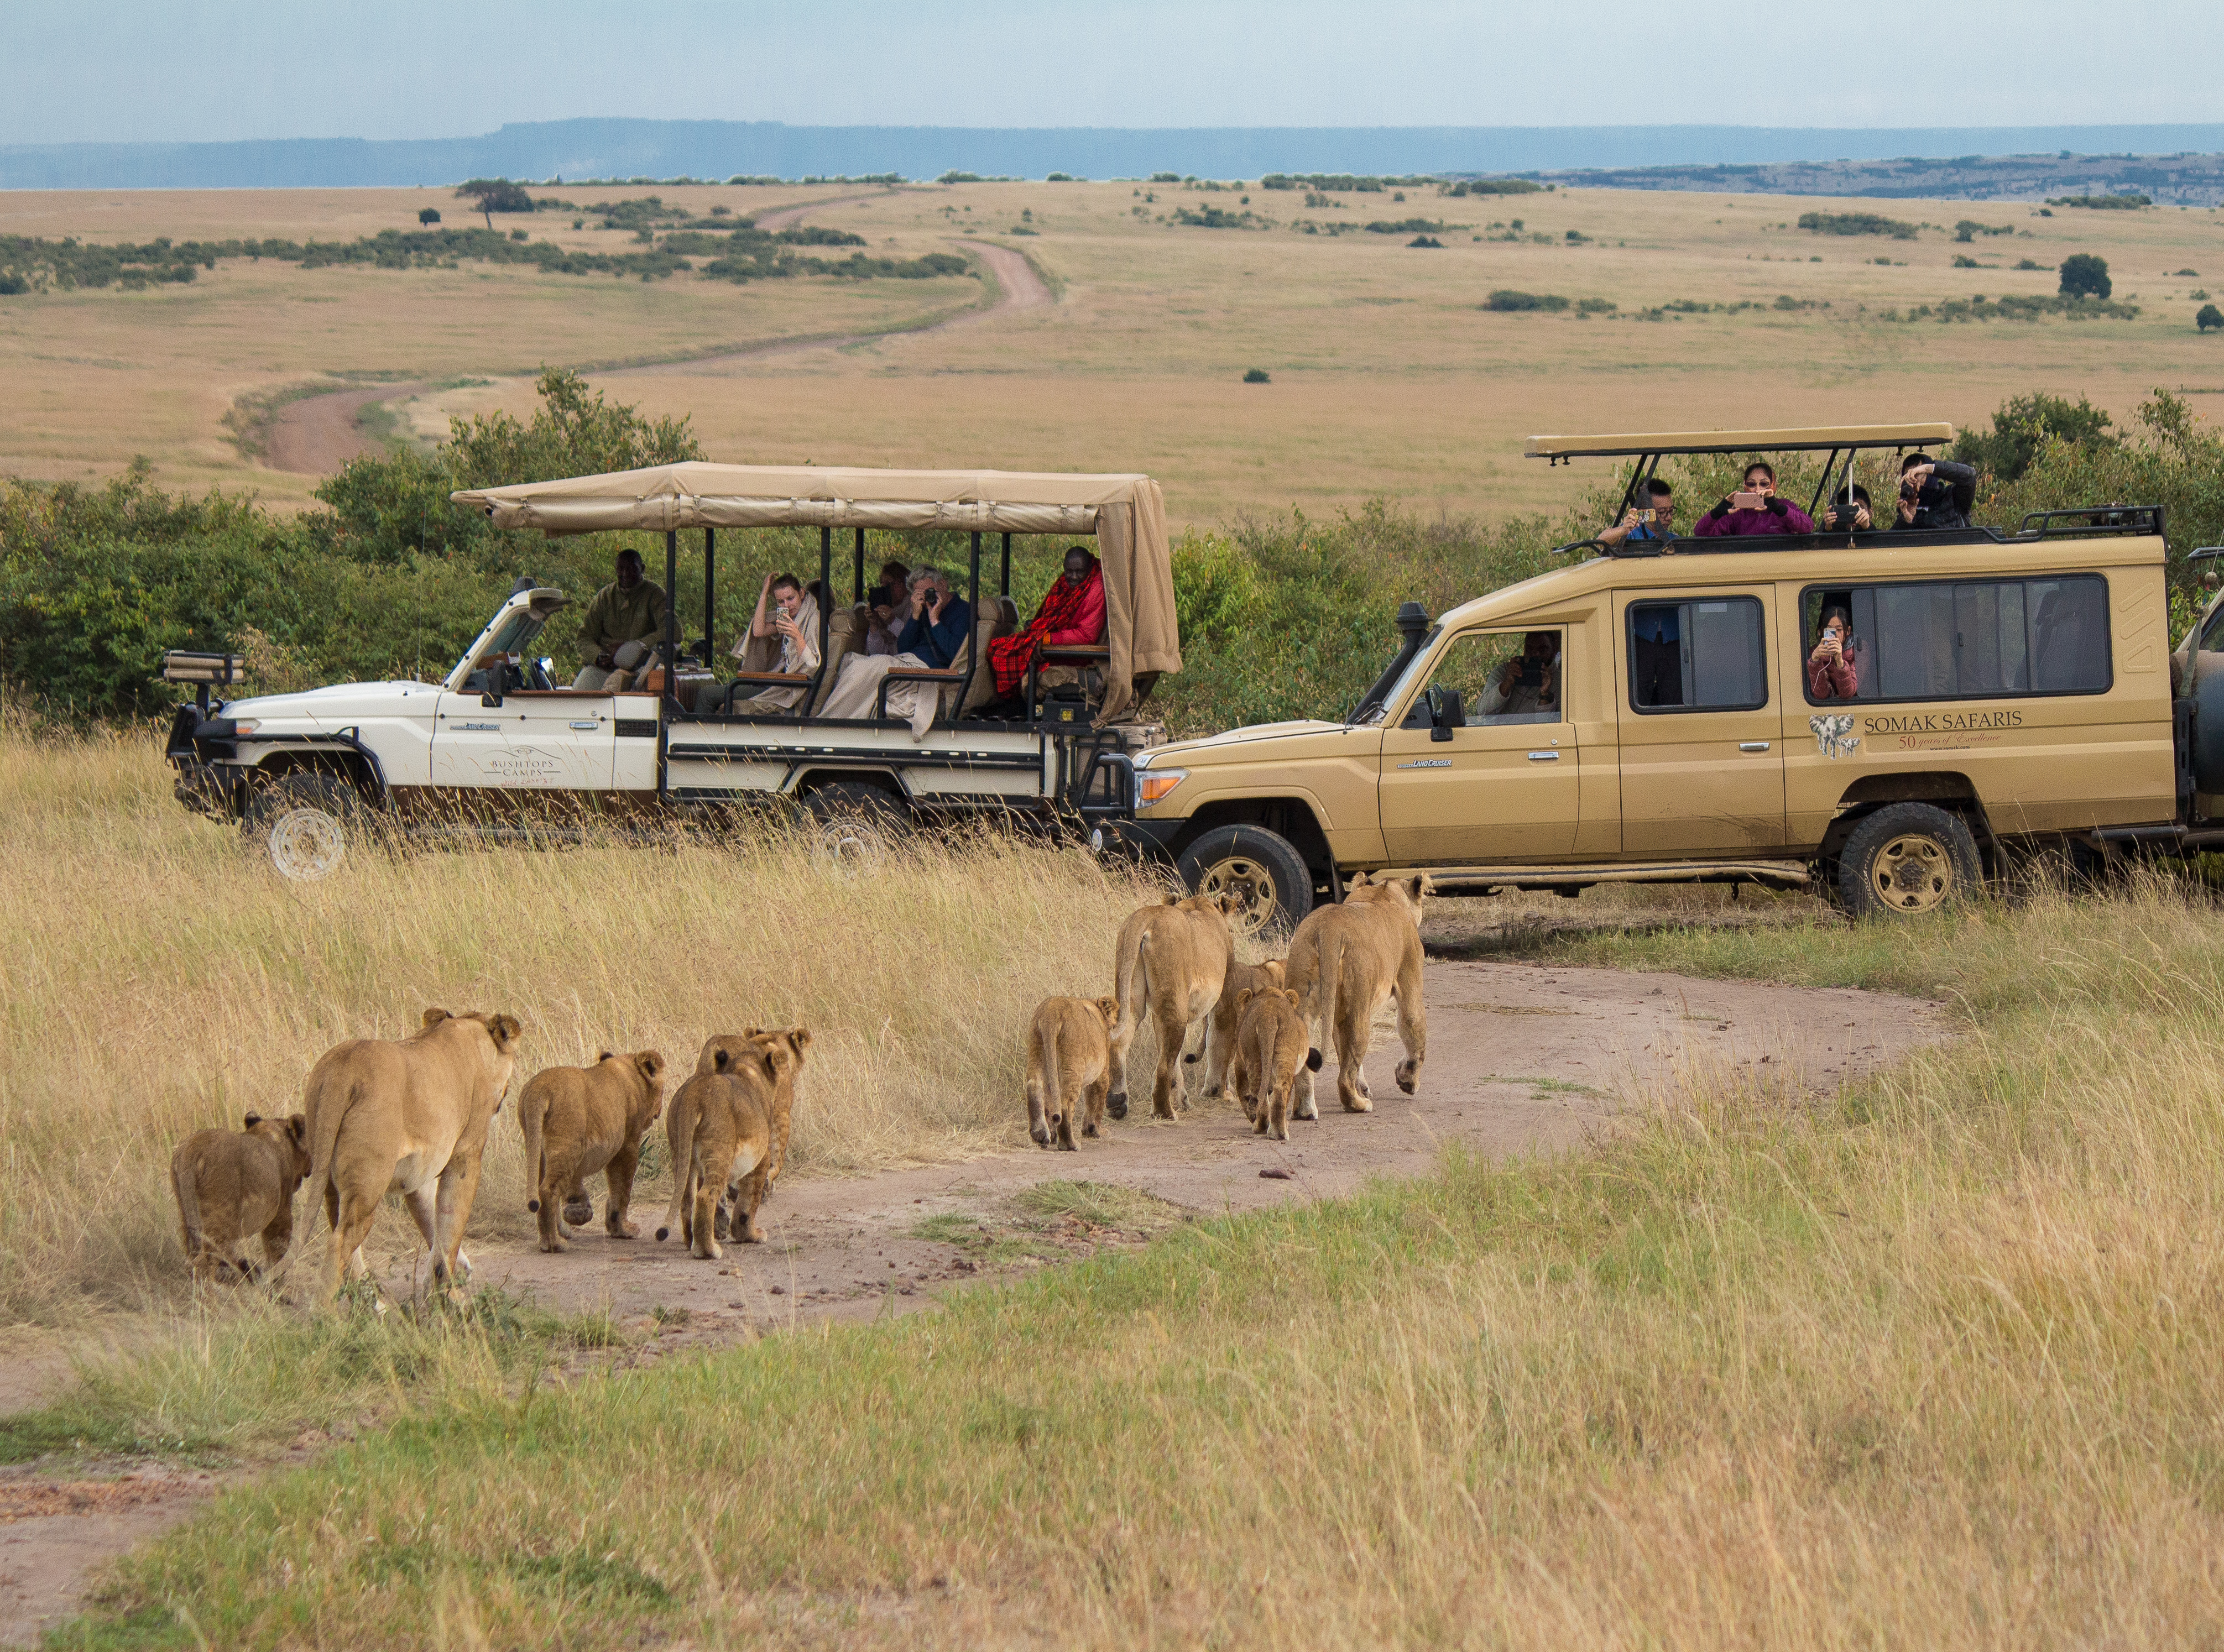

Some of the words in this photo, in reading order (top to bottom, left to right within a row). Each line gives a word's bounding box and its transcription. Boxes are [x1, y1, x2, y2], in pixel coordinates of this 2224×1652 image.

[1865, 715, 1937, 733] SOMAK
[1943, 710, 2022, 729] SAFARIS
[1899, 735, 1916, 749] 50
[1918, 738, 1940, 749] years
[1942, 735, 1952, 745] of
[1954, 732, 2001, 743] Excellence
